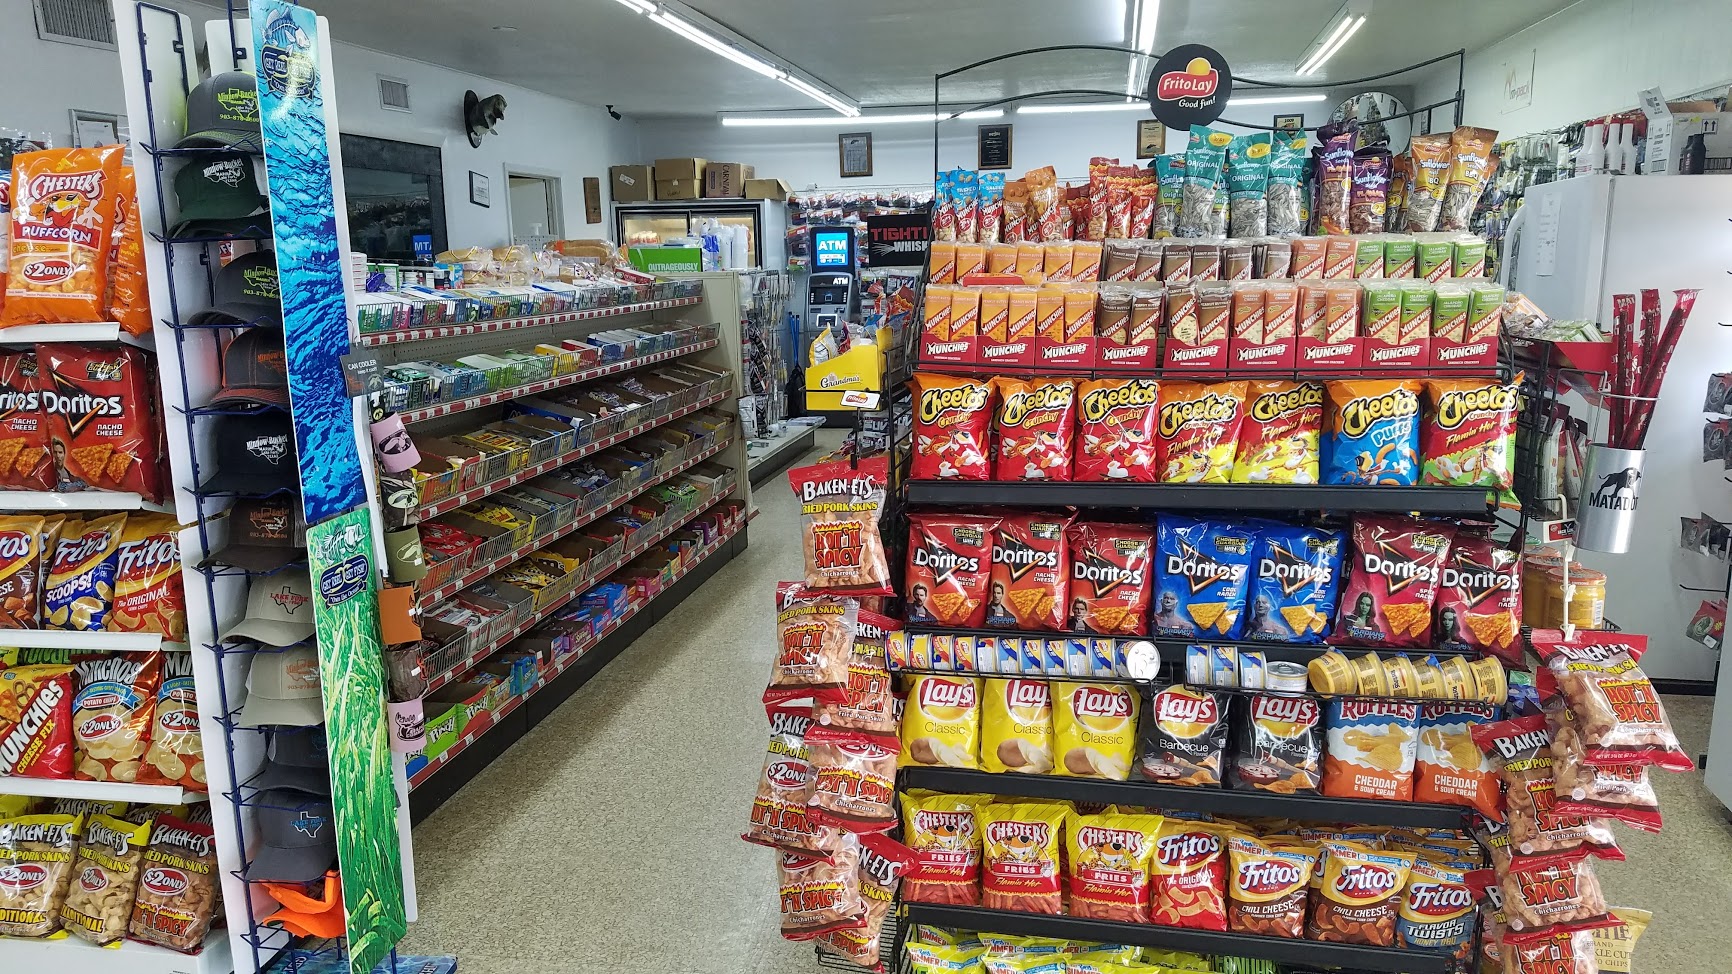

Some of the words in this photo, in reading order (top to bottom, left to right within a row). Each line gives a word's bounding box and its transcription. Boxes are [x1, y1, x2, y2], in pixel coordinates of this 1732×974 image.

[1179, 99, 1198, 108] Good
[1199, 96, 1216, 109] fun!
[1231, 173, 1265, 182] ORIGINAL
[818, 240, 847, 251] ATM
[648, 262, 699, 271] OUTRAGEOUSLY
[832, 277, 848, 285] ATM
[347, 362, 358, 370] CAN
[358, 359, 377, 368] COOLER
[43, 391, 123, 416] Doritos
[1002, 383, 1074, 426] Cheetos
[1084, 378, 1158, 422] Cheetos
[1438, 384, 1519, 430] Cheetos
[1022, 410, 1059, 429] Crunchy
[1159, 394, 1237, 439] Cheetos
[1342, 388, 1419, 438] Cheetos
[1468, 412, 1498, 421] Crunchy
[1478, 420, 1498, 433] Hot
[802, 503, 823, 514] RIED
[824, 502, 850, 513] PORK
[851, 501, 878, 512] SKINS
[53, 530, 111, 567] Fritos
[992, 545, 1057, 566] Doritos
[816, 546, 863, 569] SPICY
[914, 547, 979, 572] Doritos
[1074, 561, 1143, 585] Doritos
[1167, 556, 1241, 581] Doritos
[1259, 559, 1332, 584] Doritos
[1364, 554, 1440, 583] Doritos
[46, 570, 96, 602] SCOOPS!
[1442, 568, 1520, 590] Doritos
[818, 604, 845, 615] SKINS
[83, 698, 102, 706] POTATO
[1077, 687, 1129, 717] Lay's
[1603, 684, 1635, 704] HOT
[1159, 693, 1214, 723] Lay's
[1612, 703, 1661, 724] SPICY
[924, 721, 967, 735] Classic
[1013, 722, 1052, 735] Classic
[16, 736, 43, 774] CHEESE
[40, 718, 56, 744] FIX
[1081, 731, 1124, 745] Classic
[1159, 738, 1209, 753] Barbecue
[1503, 758, 1530, 772] FRIED
[1354, 774, 1398, 790] CHEDDAR
[1434, 773, 1478, 791] CHEDDAR
[1360, 785, 1373, 794] SOUR
[1374, 786, 1396, 797] CREAM
[1440, 785, 1454, 795] SOUR
[1455, 787, 1477, 798] CREAM
[986, 821, 1049, 849] CHESTER'S
[1078, 827, 1144, 852] CHESTER'S
[15, 850, 42, 862] PORK
[42, 851, 71, 863] SKINS
[1156, 833, 1220, 864] Fritos
[161, 855, 186, 869] PORK
[185, 860, 211, 875] SKINS
[931, 853, 962, 862] FRIES
[1004, 865, 1036, 874] FRIES
[1094, 872, 1127, 882] FRIES
[1238, 859, 1301, 889] Fritos
[1024, 880, 1042, 888] Hot
[1336, 865, 1396, 893] Fritos
[1114, 887, 1133, 897] Hot
[1409, 882, 1472, 911] Fritos
[1521, 877, 1579, 907] SPICY
[1241, 904, 1261, 914] CHILI
[1262, 899, 1295, 914] CHEESE
[1333, 905, 1354, 917] CHILI
[1355, 906, 1388, 918] CHEESE
[1533, 902, 1582, 916] Chicharrones
[154, 914, 193, 937] SPICY
[1406, 922, 1466, 939] TWISTS
[1418, 920, 1457, 931] FLAVOR
[1413, 937, 1440, 946] HONEY
[1605, 958, 1629, 968] CHIPS
